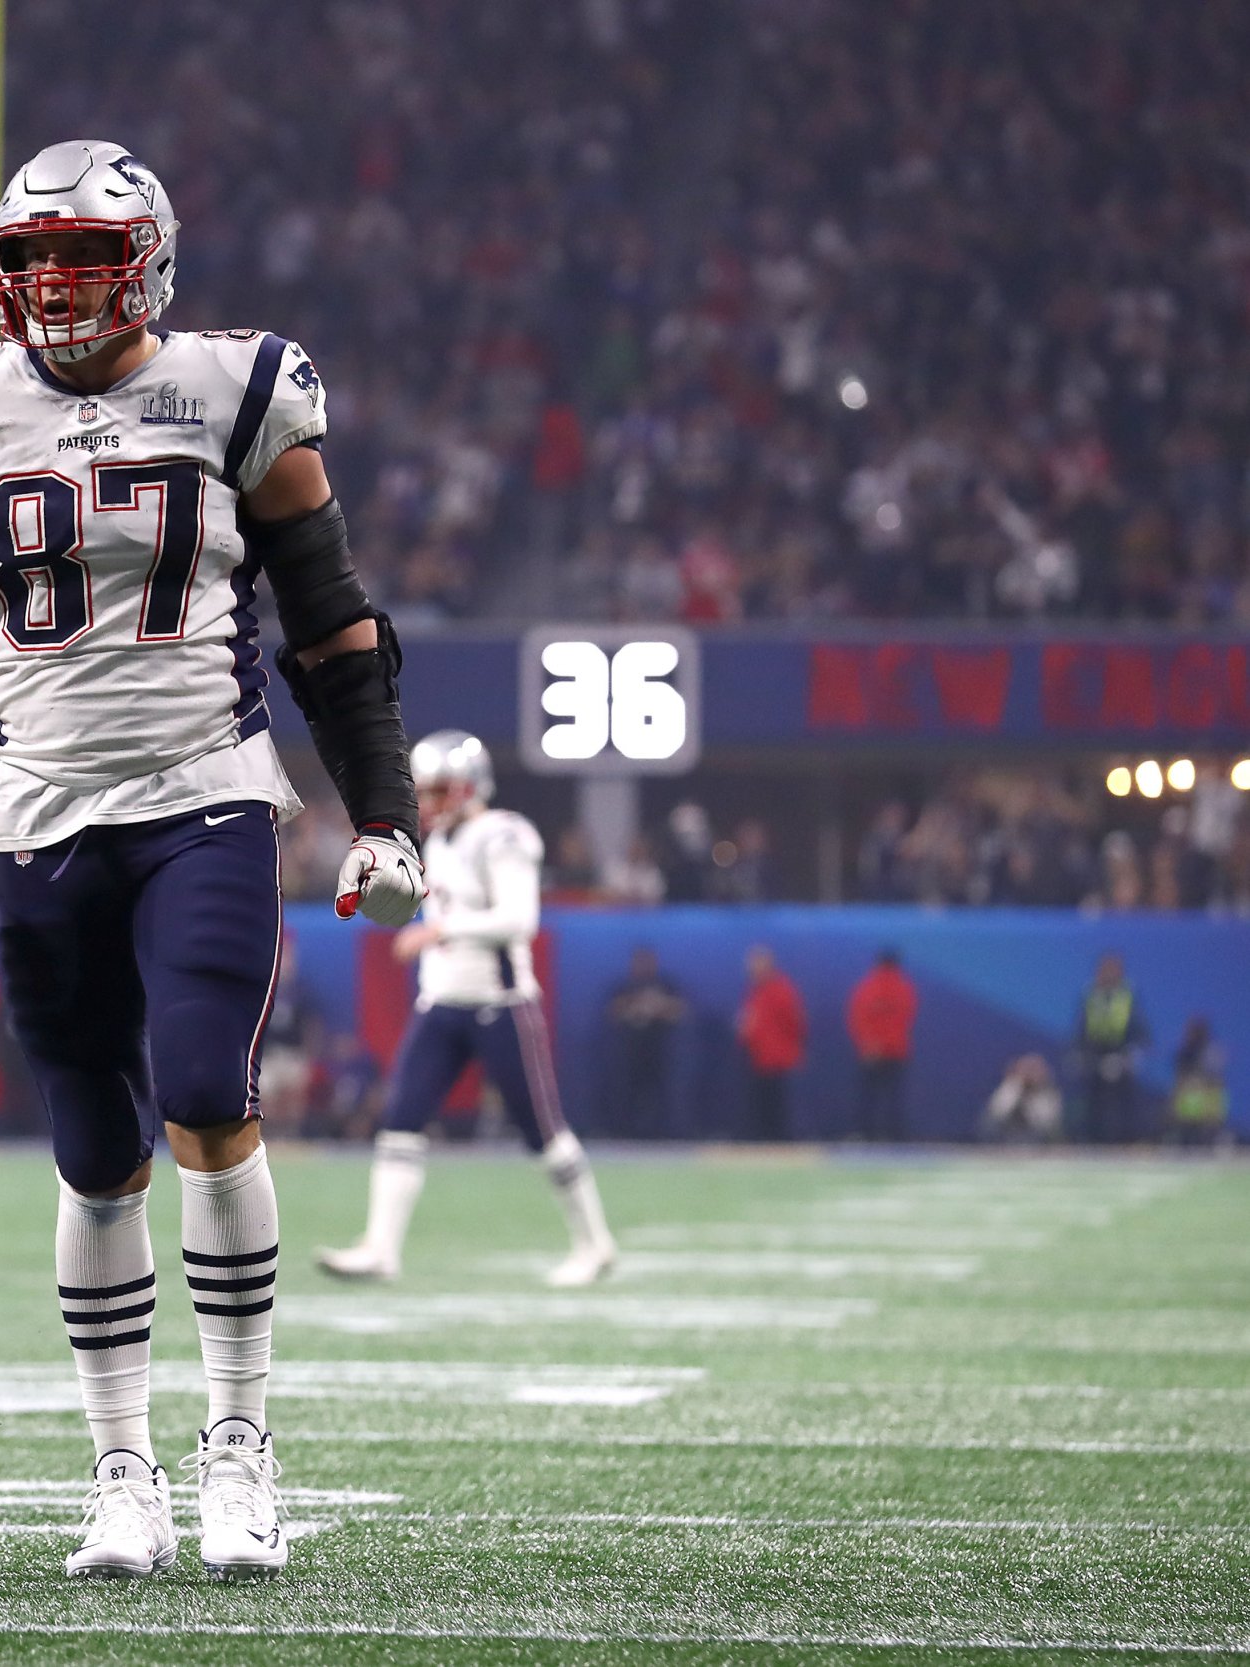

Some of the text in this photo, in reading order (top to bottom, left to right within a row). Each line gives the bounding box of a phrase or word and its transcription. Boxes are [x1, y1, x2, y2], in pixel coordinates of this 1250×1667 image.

[58, 435, 120, 452] PATRIOTS
[807, 641, 1012, 732] NEW
[541, 641, 687, 759] 36
[227, 1434, 246, 1446] 87
[110, 1465, 127, 1480] 87
